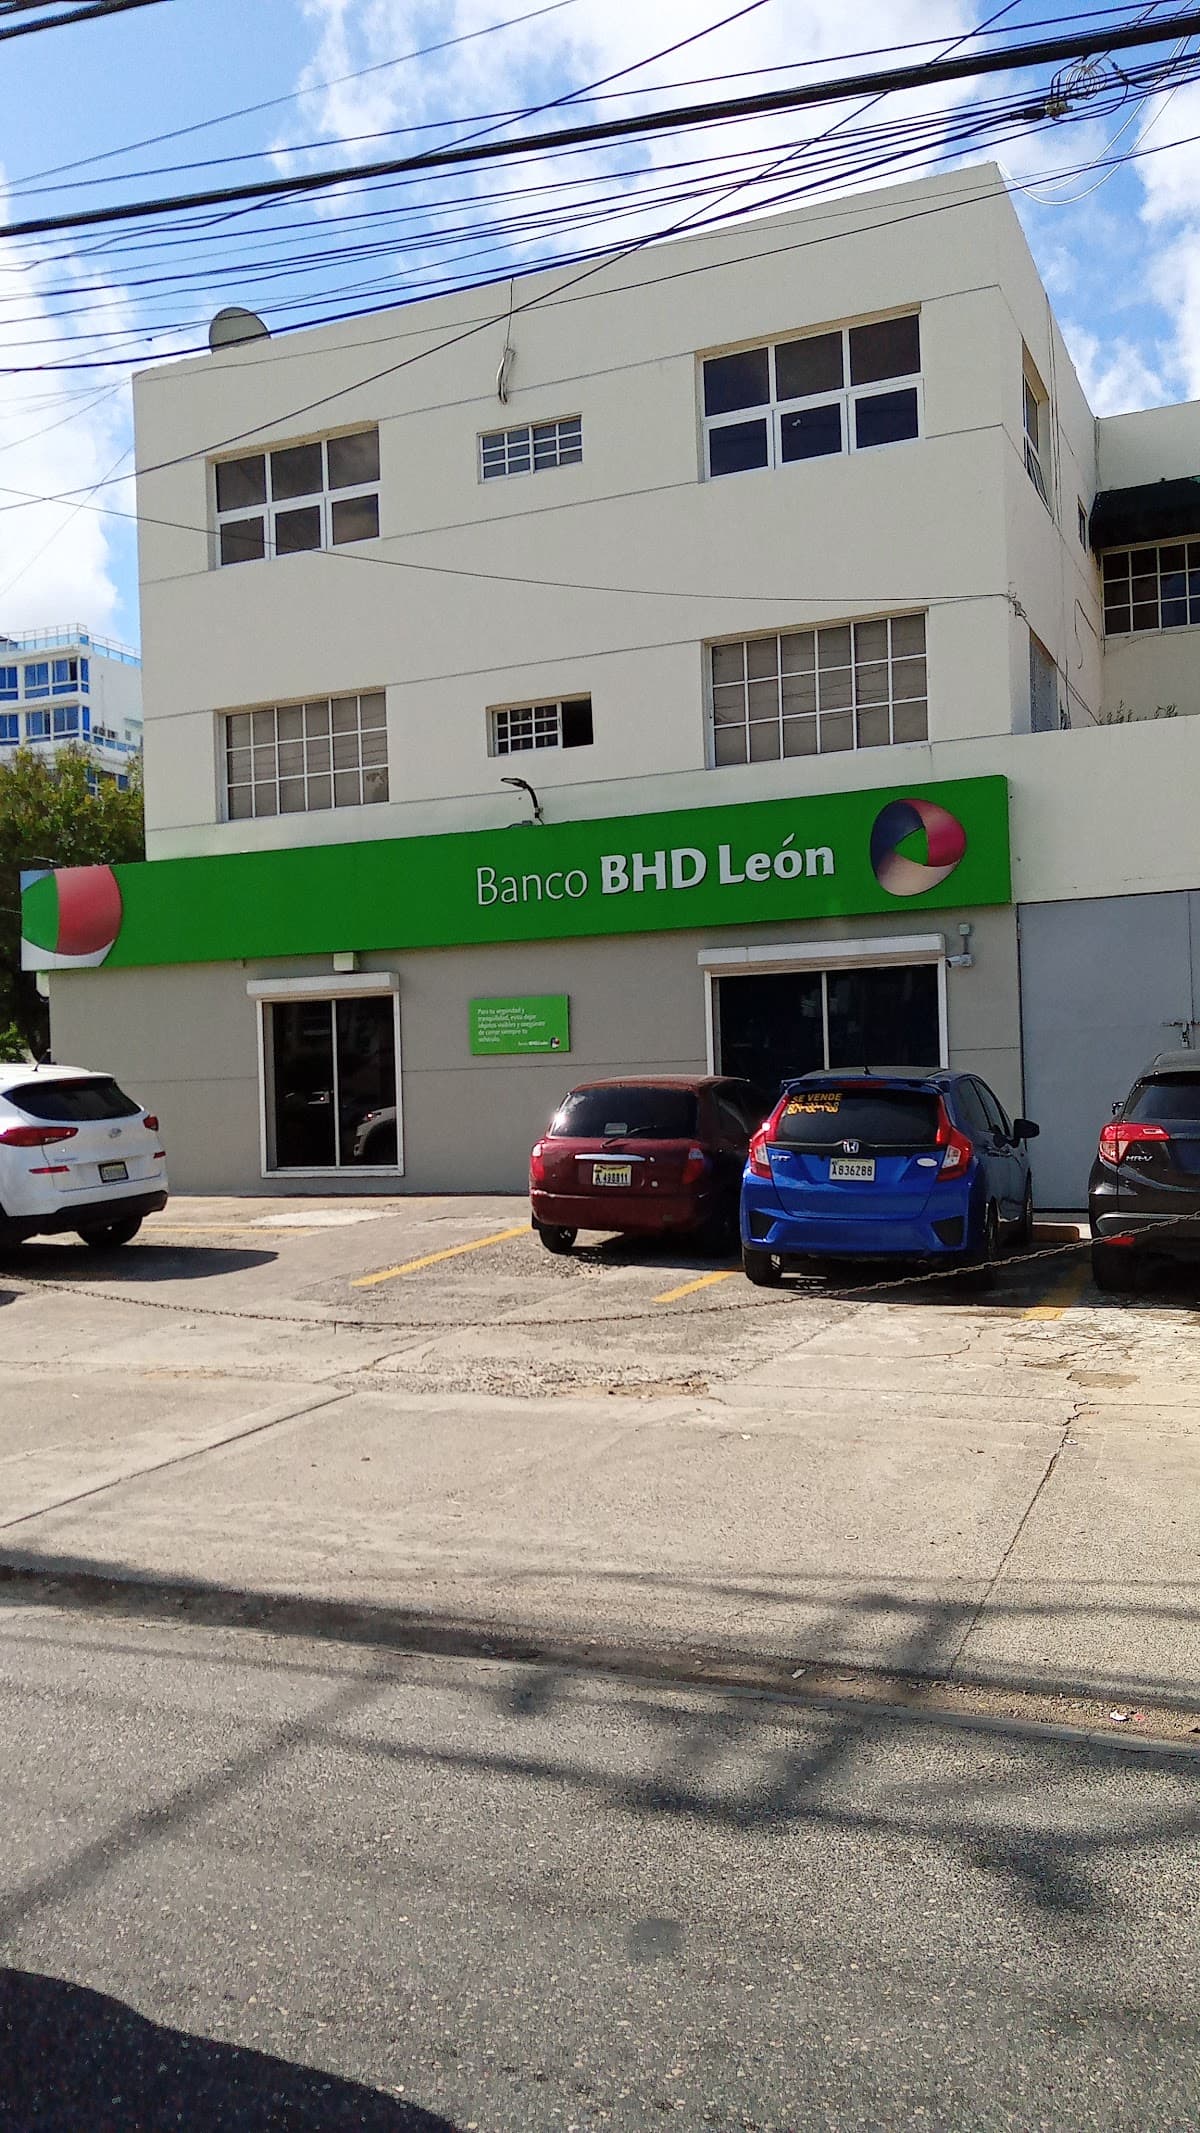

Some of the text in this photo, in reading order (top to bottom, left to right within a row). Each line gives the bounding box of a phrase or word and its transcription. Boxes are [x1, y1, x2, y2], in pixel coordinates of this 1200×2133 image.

[477, 833, 834, 905] Banco BHD León
[793, 1093, 842, 1102] SE VENDE
